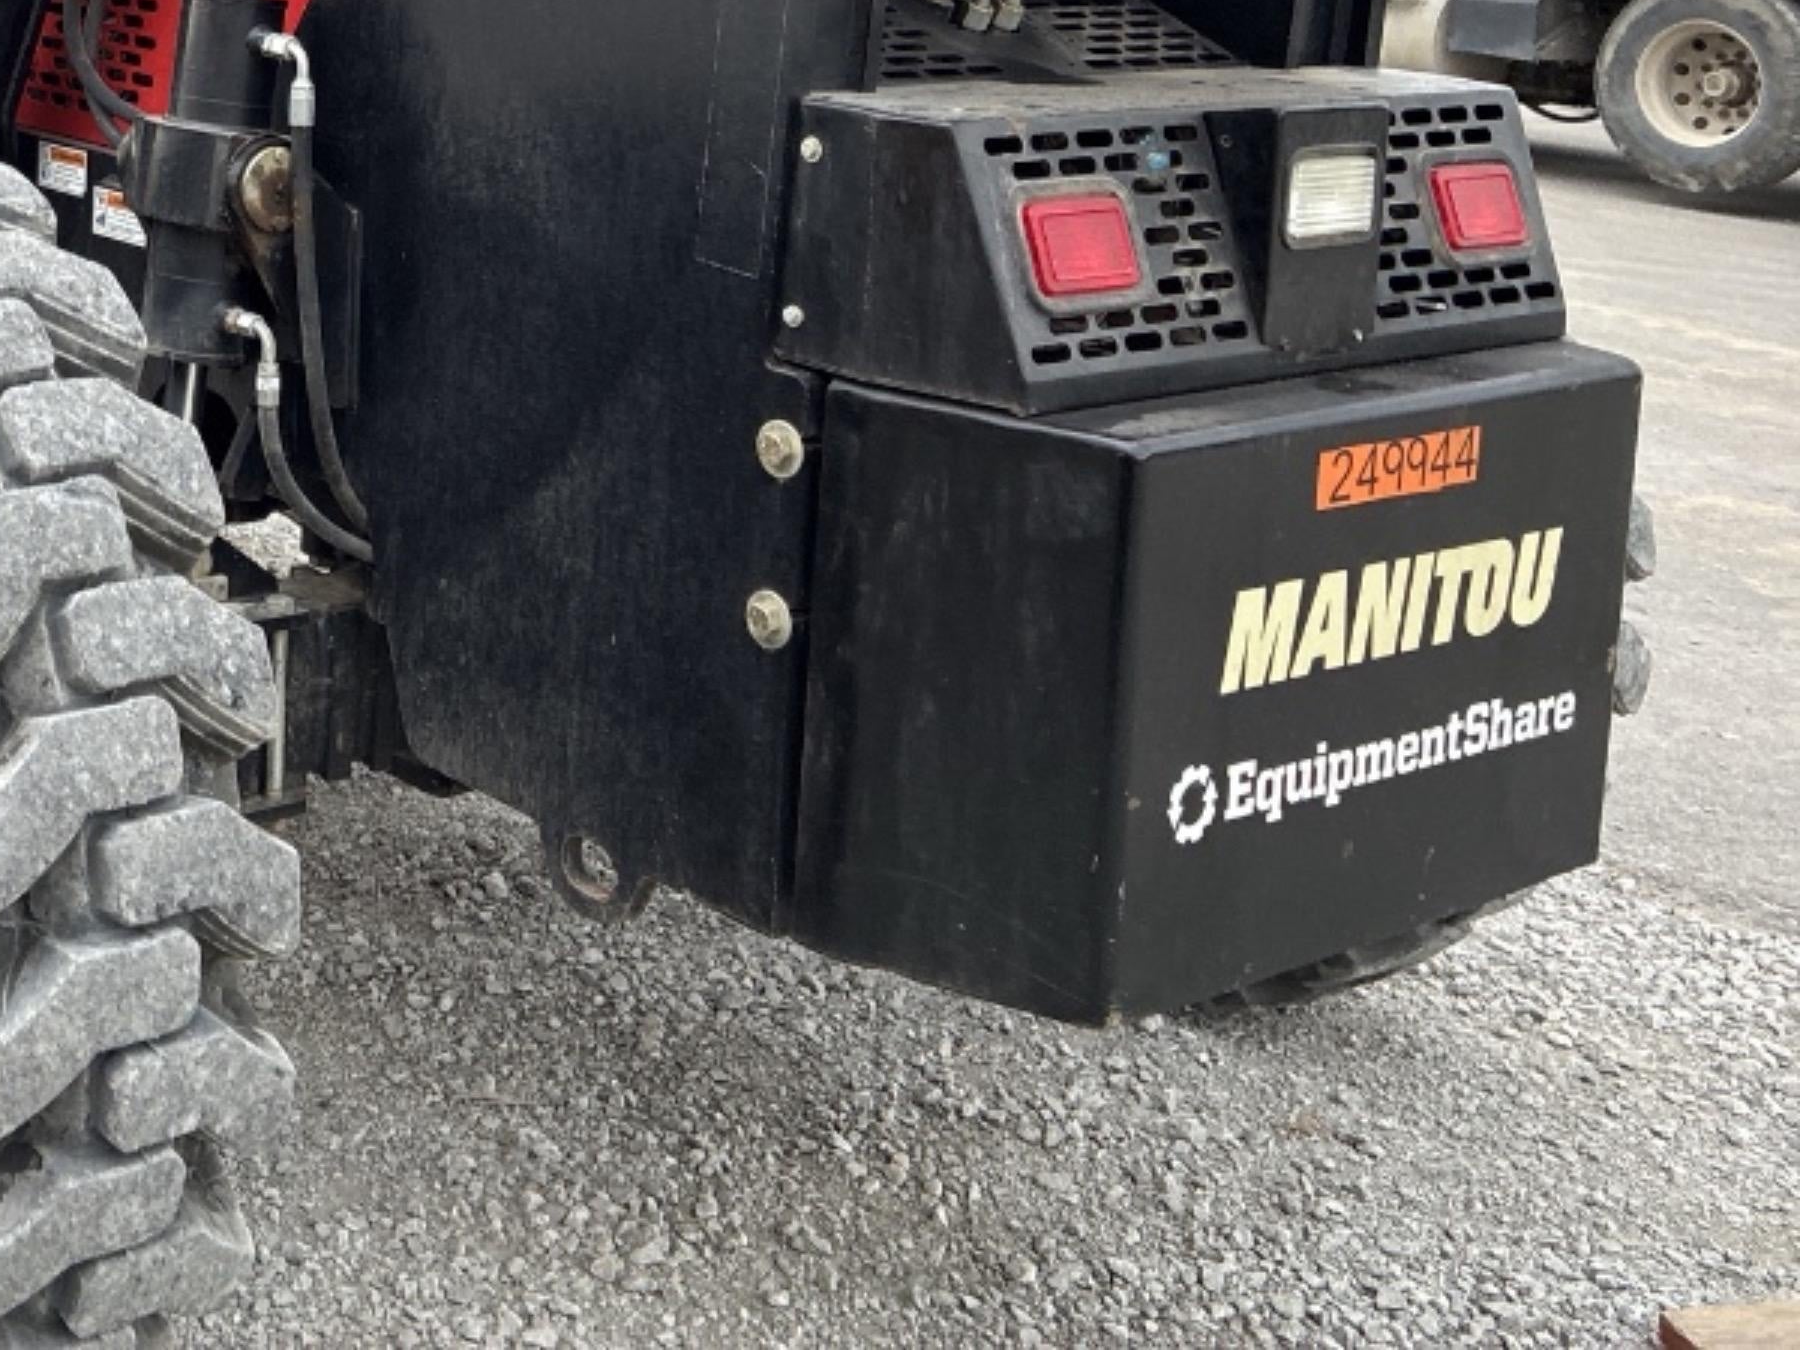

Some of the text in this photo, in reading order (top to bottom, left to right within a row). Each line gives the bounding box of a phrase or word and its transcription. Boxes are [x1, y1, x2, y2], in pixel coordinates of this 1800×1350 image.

[1328, 426, 1476, 503] 249944
[1219, 526, 1565, 696] MANITOU
[1223, 689, 1577, 823] EquipmentShare
